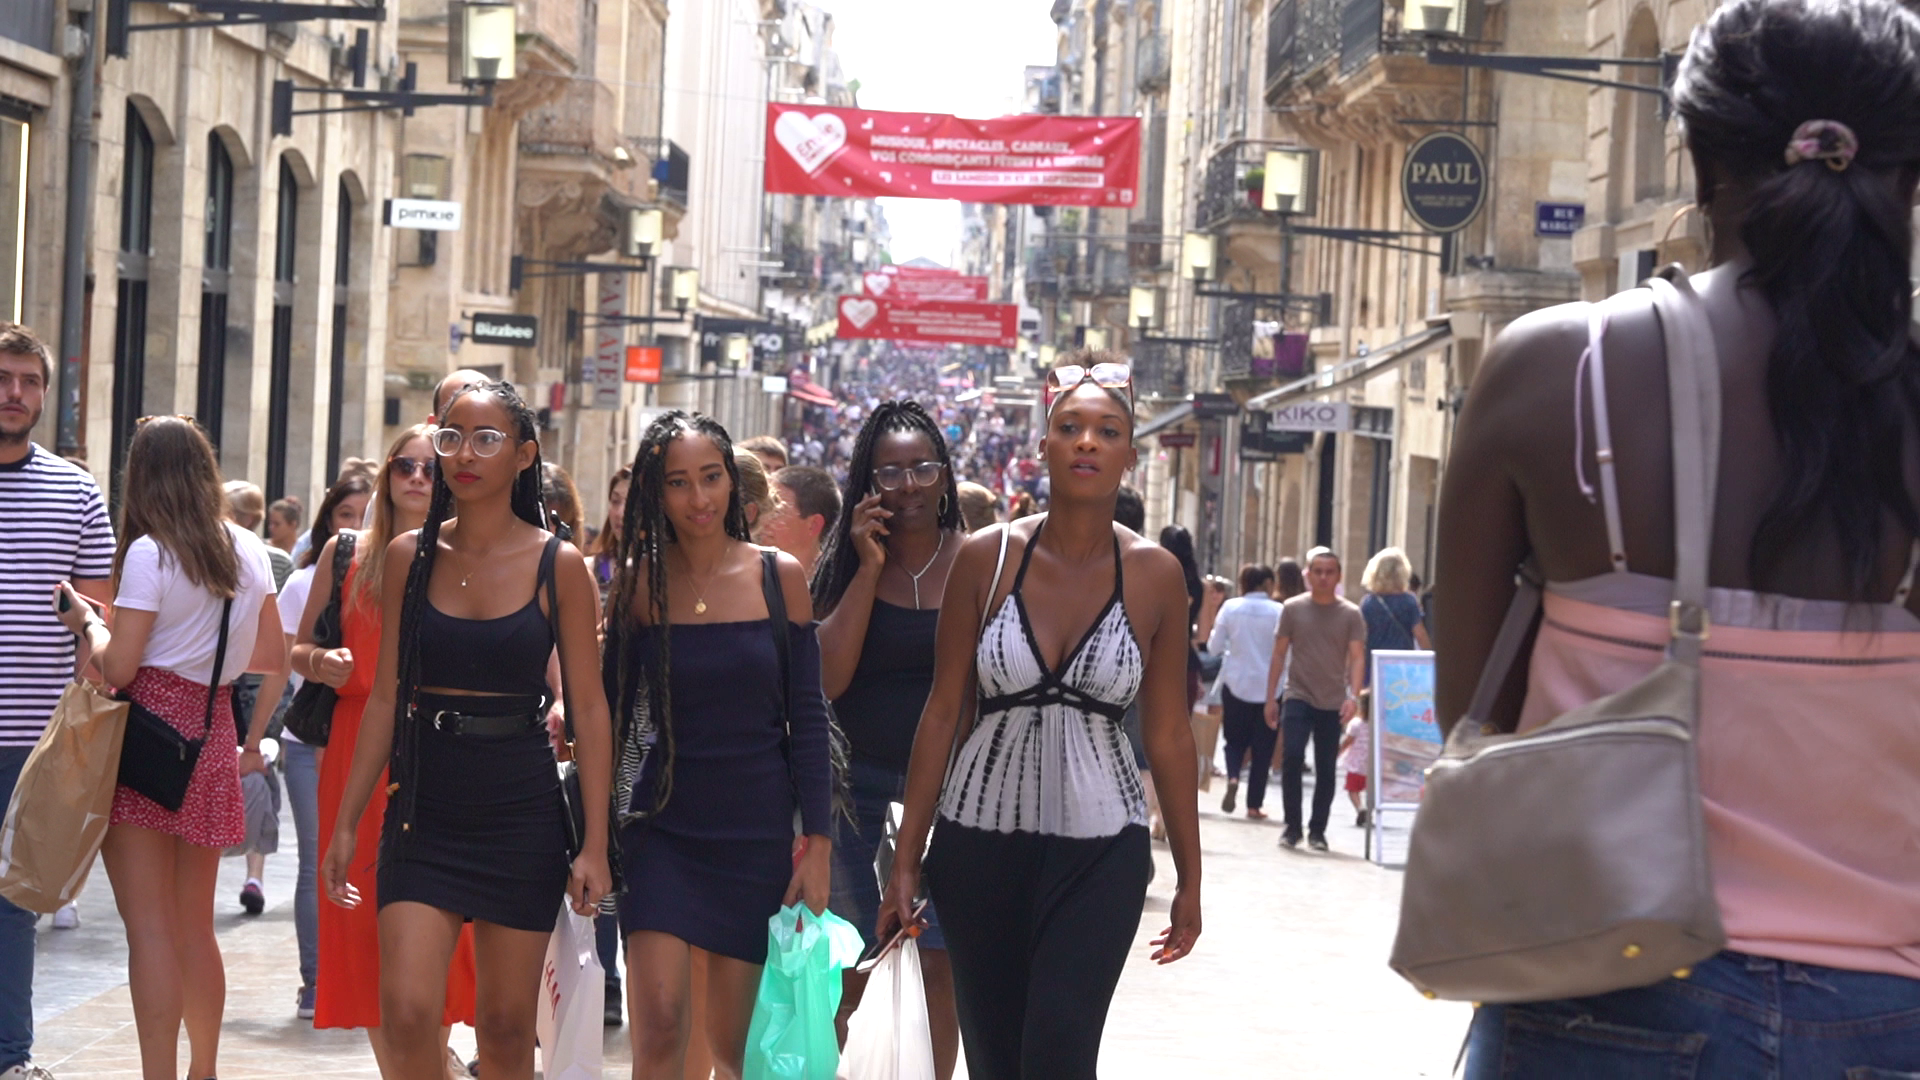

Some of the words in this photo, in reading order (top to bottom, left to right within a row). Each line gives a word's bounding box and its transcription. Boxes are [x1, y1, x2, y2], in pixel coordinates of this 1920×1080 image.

[869, 149, 897, 163] VOS
[1035, 155, 1053, 168] LA
[1411, 161, 1478, 185] PAUL
[398, 208, 454, 221] pimkie
[1553, 208, 1575, 219] RUE
[474, 321, 534, 339] Bizzbee
[1277, 405, 1336, 422] KIKO
